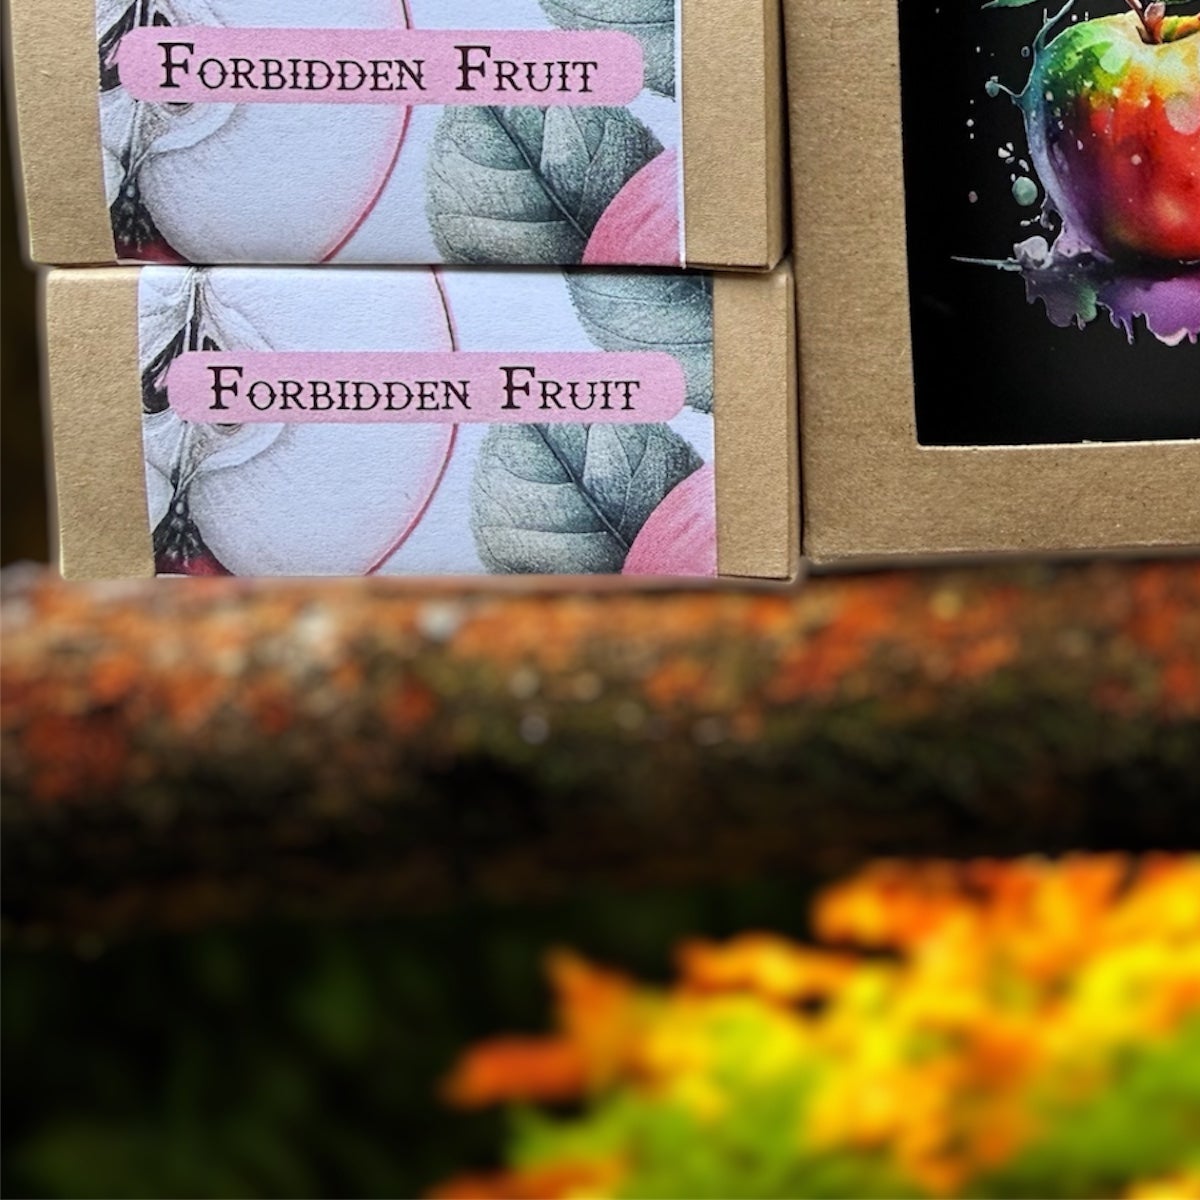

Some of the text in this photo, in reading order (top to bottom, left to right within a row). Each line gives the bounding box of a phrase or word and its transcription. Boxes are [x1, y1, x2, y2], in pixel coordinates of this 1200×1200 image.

[157, 42, 598, 93] FORBIDDEN FRUIT
[207, 366, 640, 411] FORBIDDEN FRUIT
